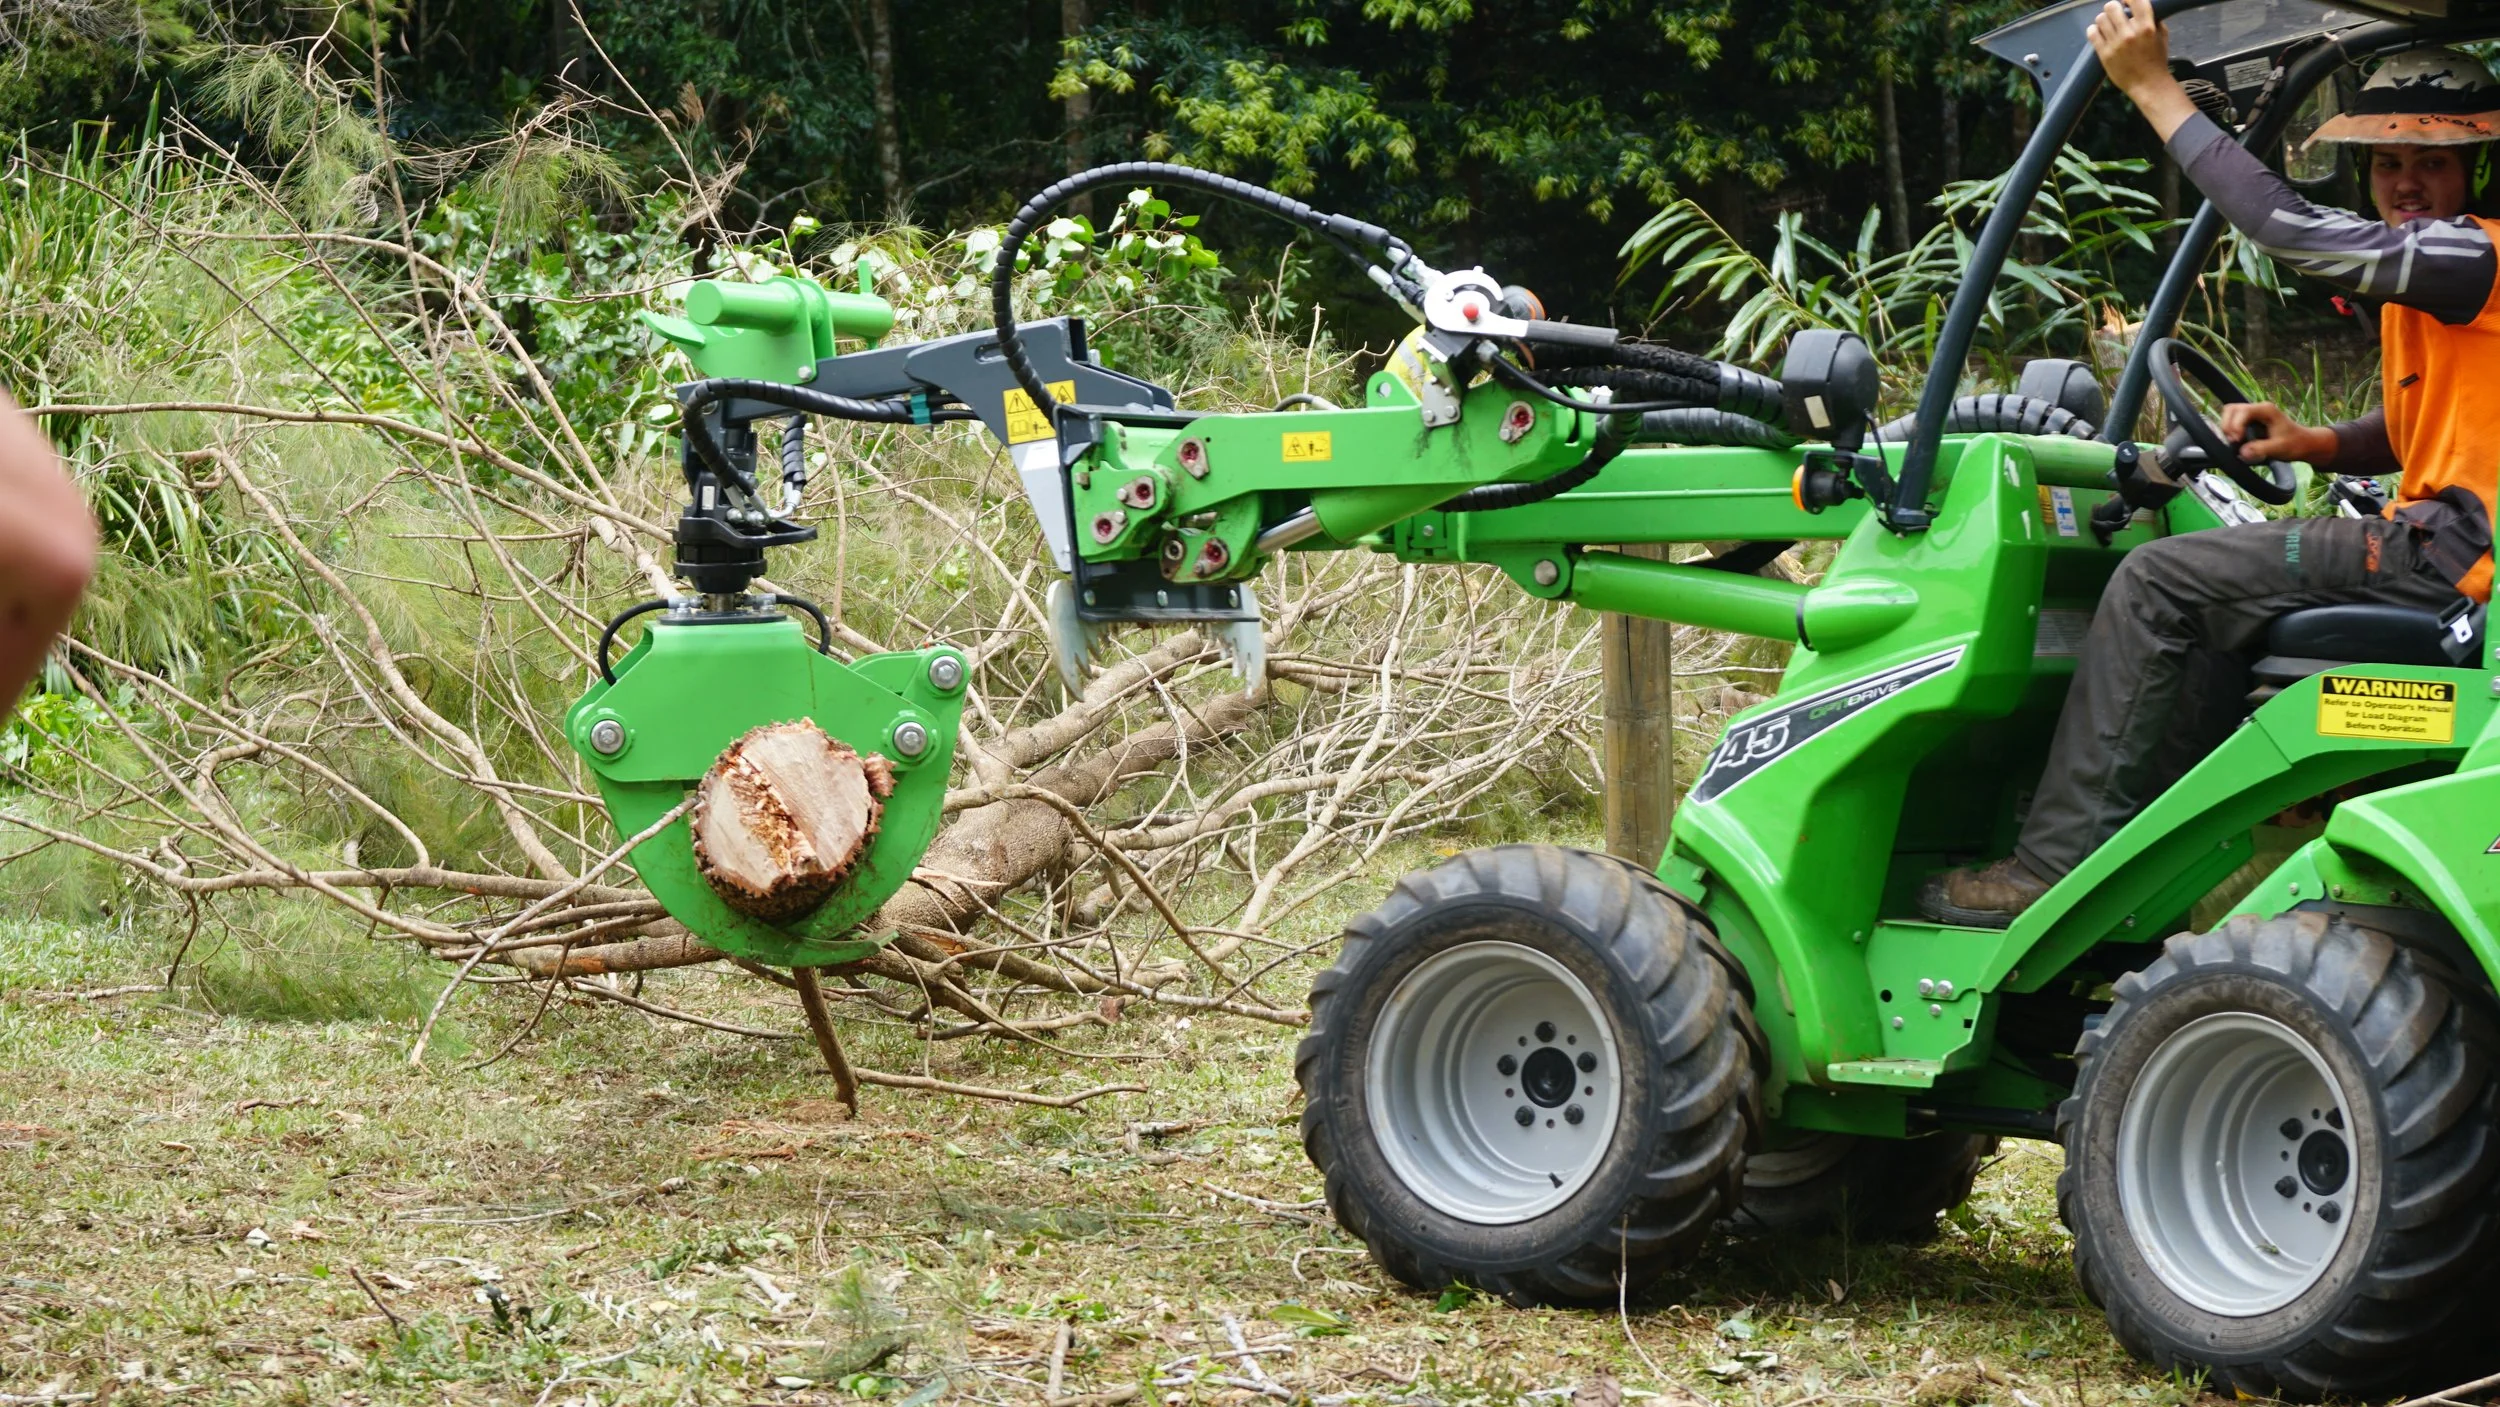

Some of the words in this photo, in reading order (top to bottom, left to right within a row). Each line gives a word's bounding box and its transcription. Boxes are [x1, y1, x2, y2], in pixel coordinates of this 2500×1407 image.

[2331, 678, 2446, 700] WARNING
[2324, 698, 2349, 706] Refer
[2364, 701, 2414, 710] Operator's
[2417, 704, 2450, 713] Manual
[2345, 710, 2359, 718] for
[2362, 711, 2385, 720] Load
[2387, 712, 2428, 723] Diagram
[2345, 721, 2376, 730] Before
[2379, 723, 2427, 733] Operation
